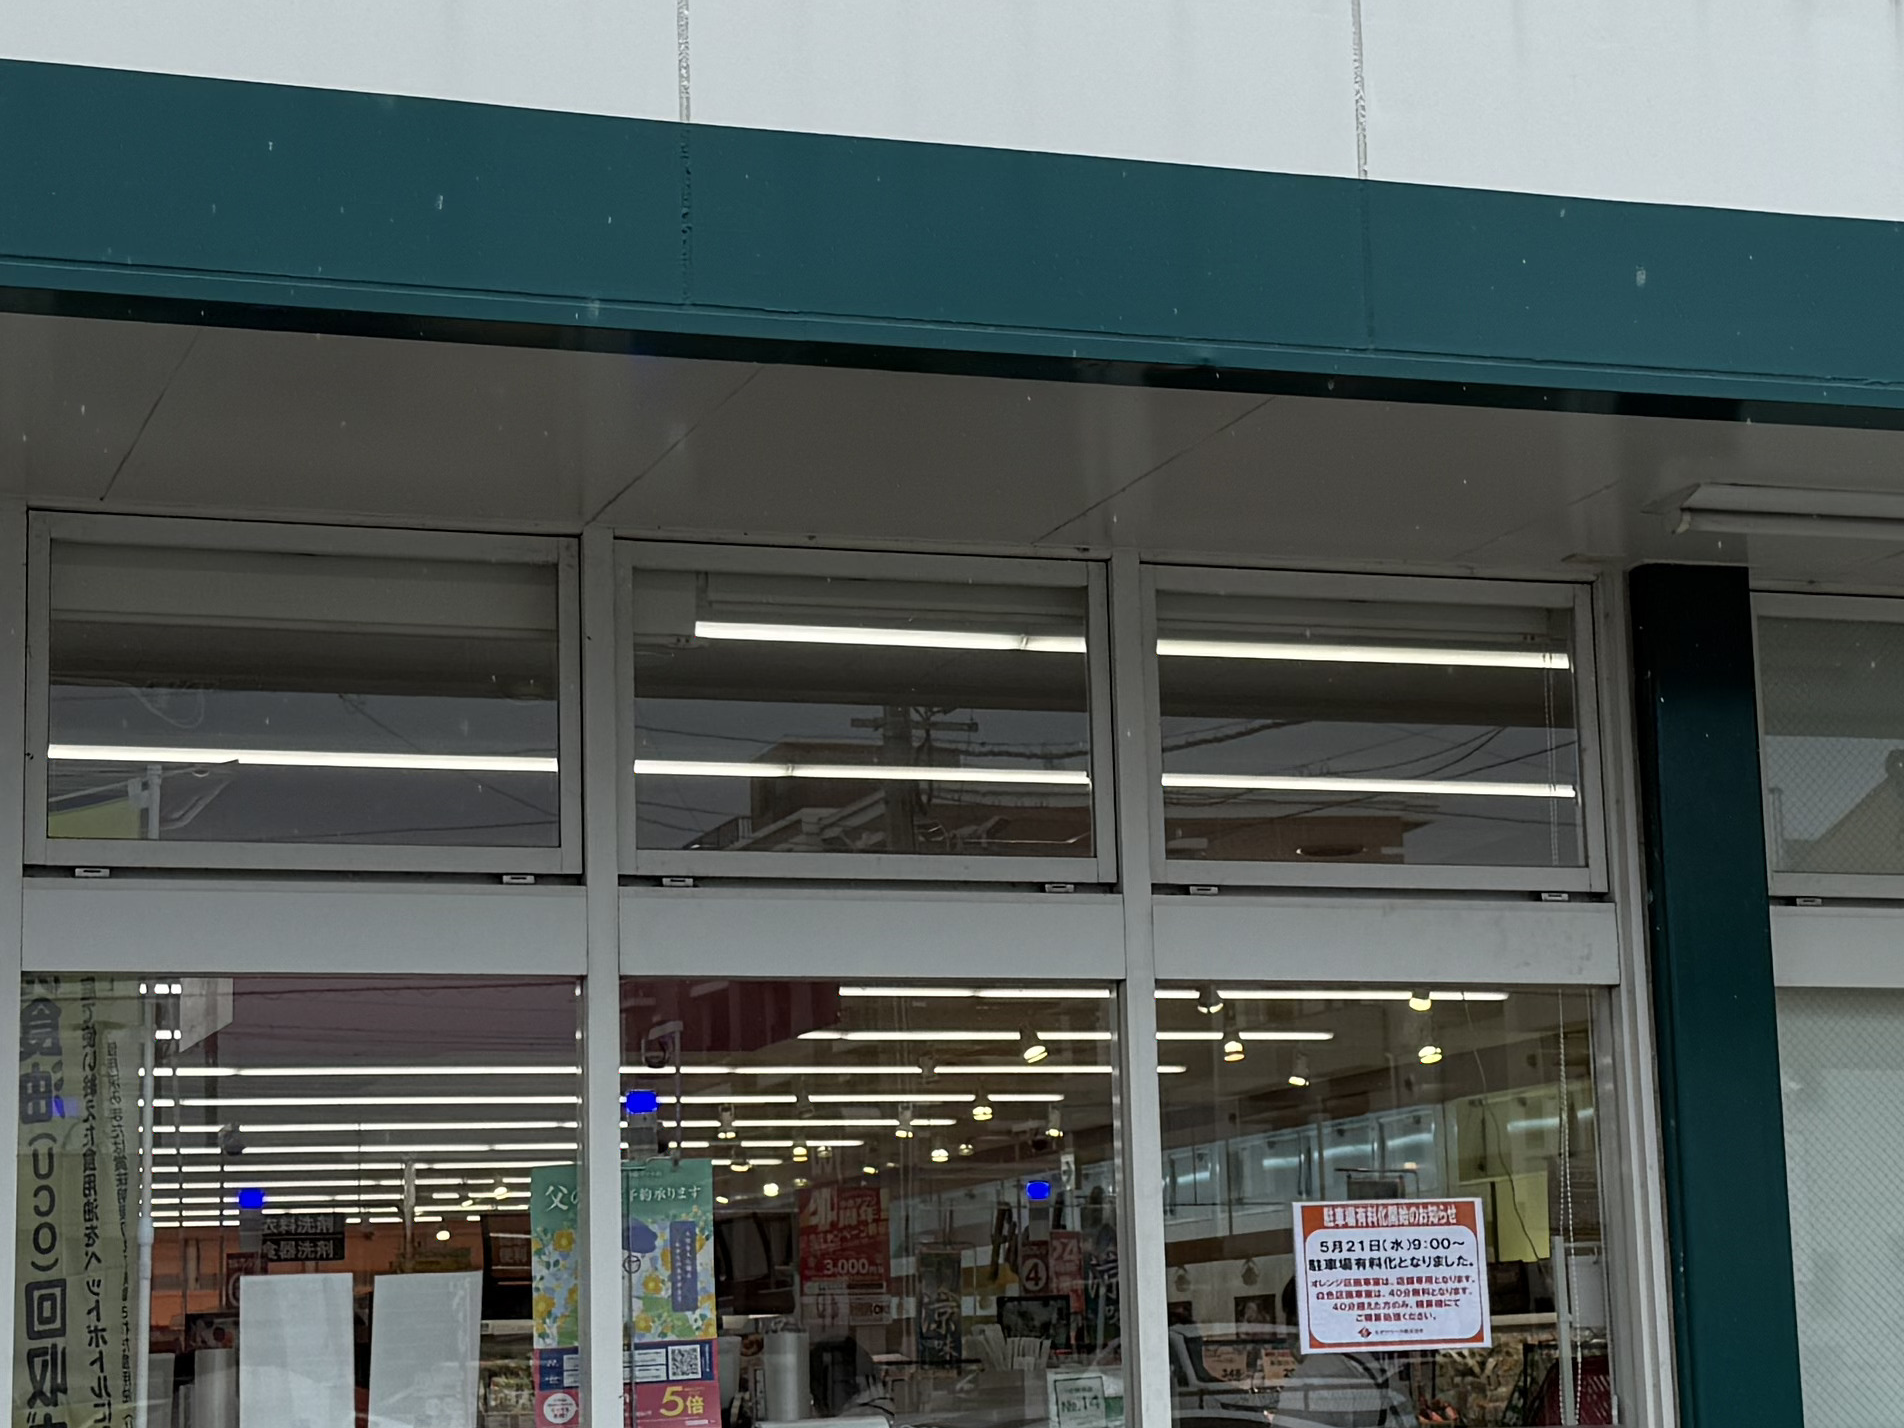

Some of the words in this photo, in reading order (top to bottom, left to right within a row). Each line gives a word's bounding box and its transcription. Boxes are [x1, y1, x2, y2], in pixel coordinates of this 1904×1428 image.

[263, 1214, 335, 1234] 衣料洗剤
[1323, 1204, 1457, 1227] 駐車場有料化開始のお知らせ
[262, 1240, 335, 1259] 食器洗剤
[1308, 1255, 1474, 1272] 駐車場有料化となりました。
[660, 1385, 705, 1417] 5倍
